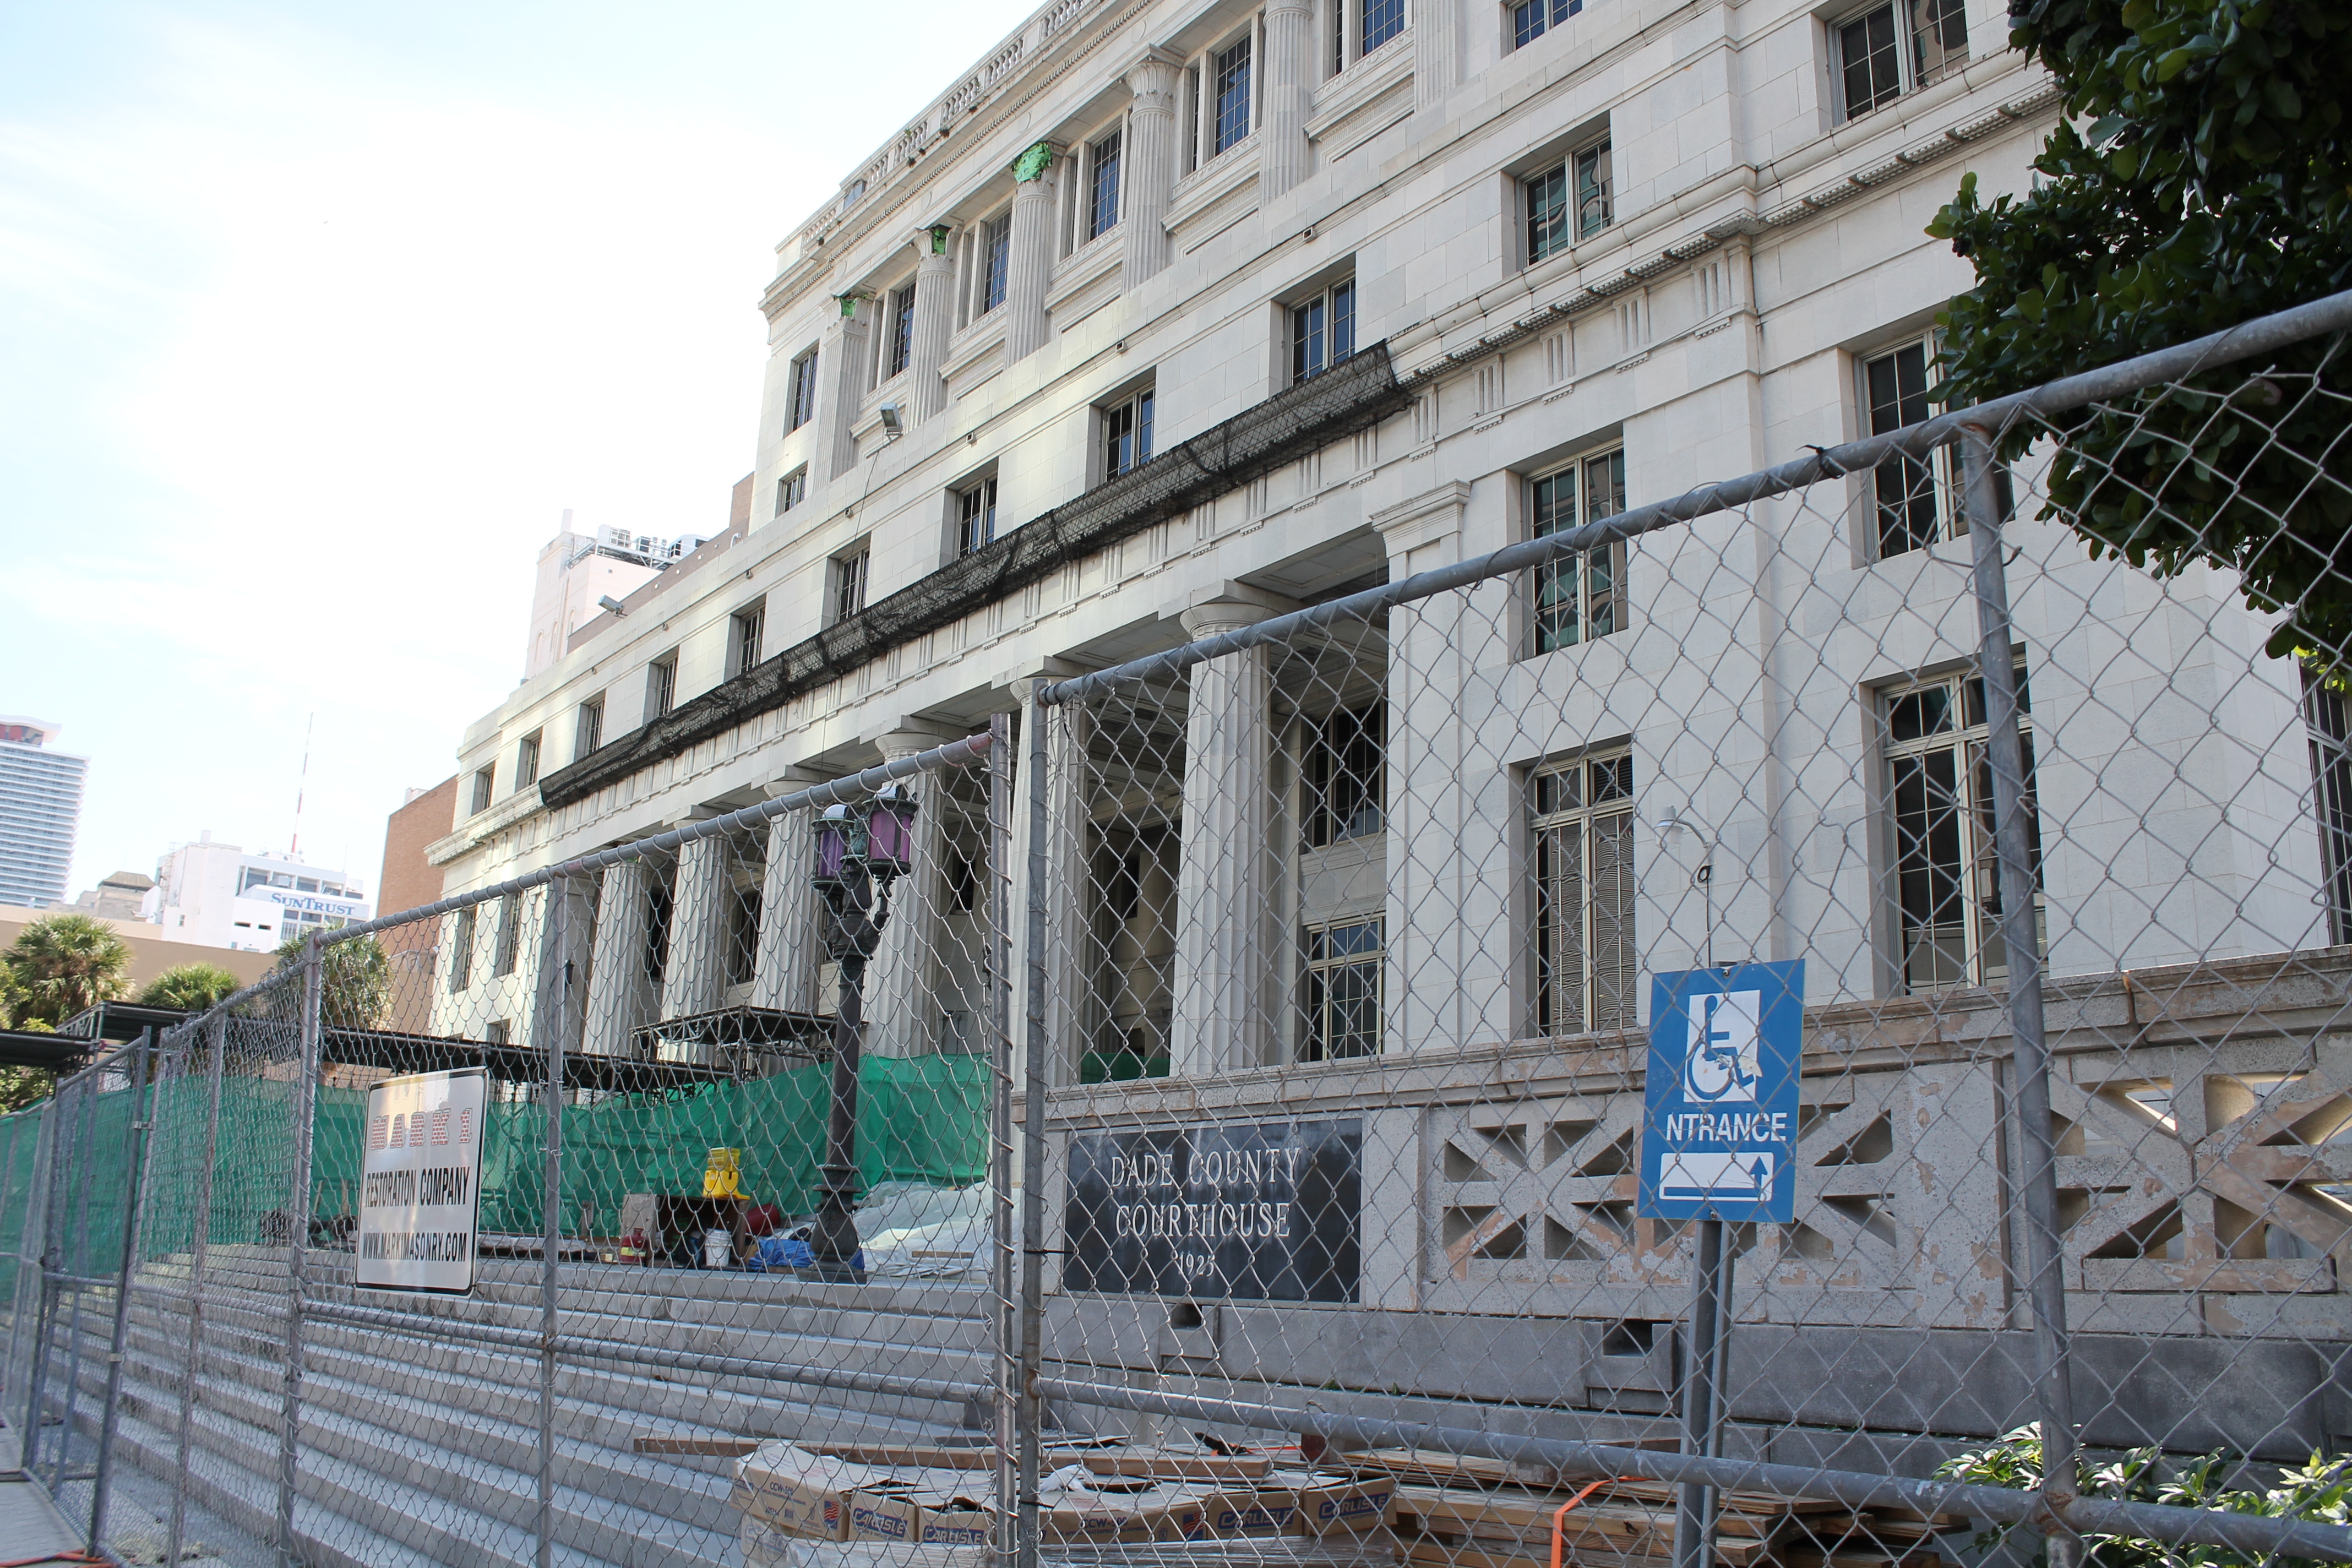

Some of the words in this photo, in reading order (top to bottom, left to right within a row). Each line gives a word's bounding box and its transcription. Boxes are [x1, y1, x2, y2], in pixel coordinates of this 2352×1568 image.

[271, 892, 355, 915] SUNTRUST
[371, 1108, 451, 1150] MARK
[459, 1107, 473, 1144] 1
[1666, 1112, 1788, 1142] NTRANCE
[1112, 1153, 1174, 1188] DADE
[1188, 1147, 1301, 1185] COUNTY
[365, 1169, 417, 1208] RESTORATION
[420, 1166, 471, 1206] COMPANY
[1115, 1202, 1291, 1238] COURTHOUSE
[362, 1232, 467, 1262] WWW.MARK1MASONRY.COM
[1178, 1253, 1216, 1277] 1925
[853, 1508, 906, 1536] CARLISLE
[923, 1526, 983, 1544] CARLISLE
